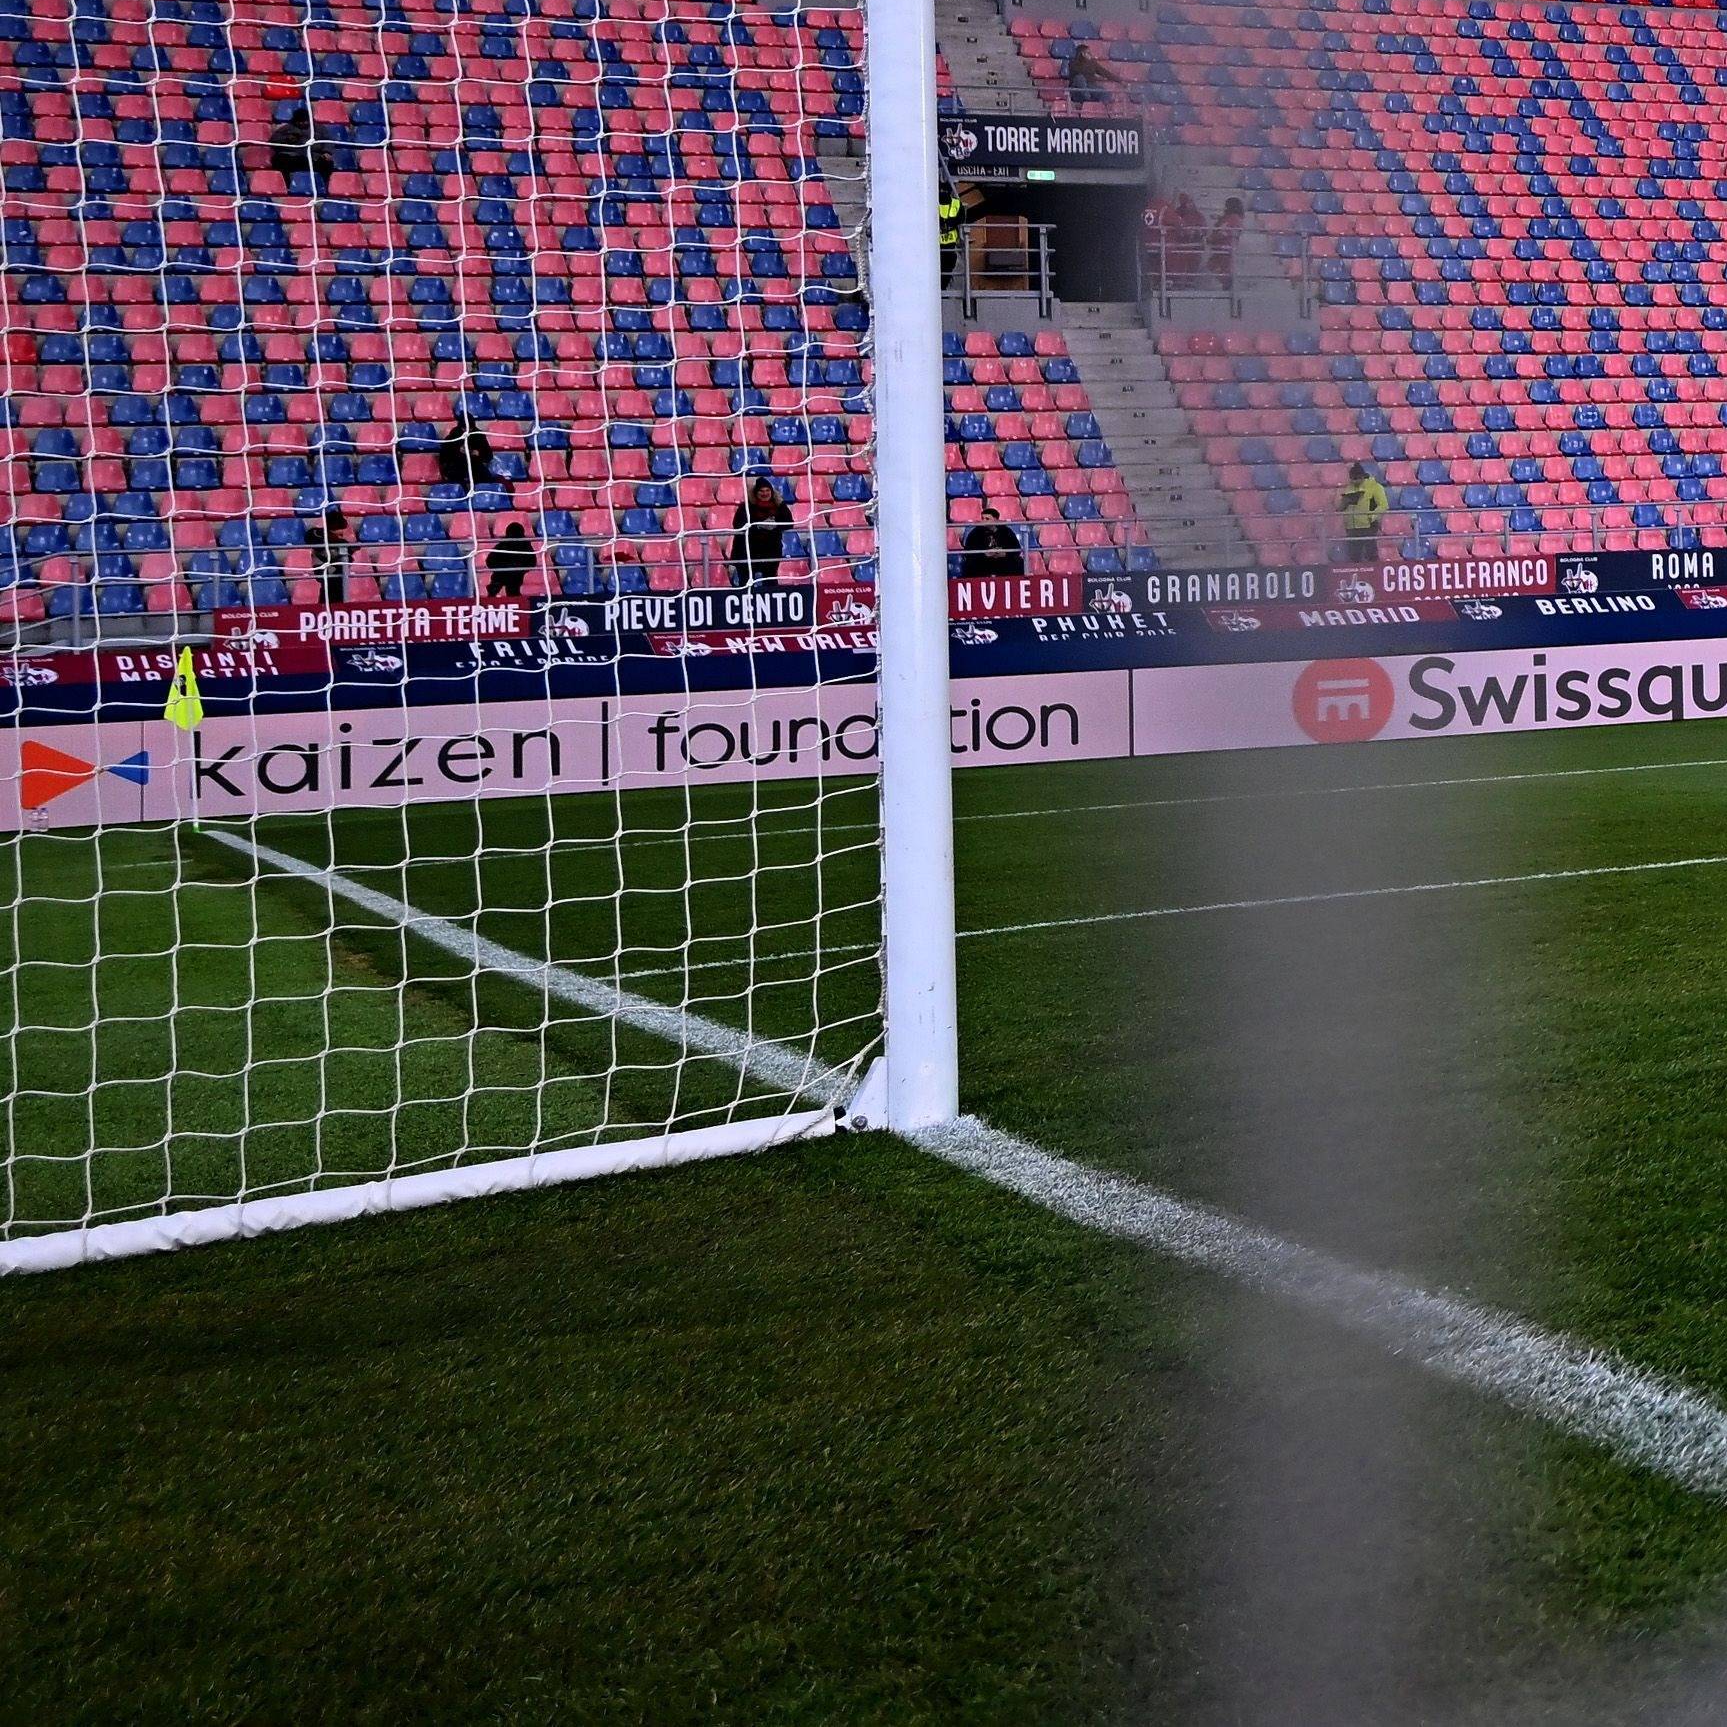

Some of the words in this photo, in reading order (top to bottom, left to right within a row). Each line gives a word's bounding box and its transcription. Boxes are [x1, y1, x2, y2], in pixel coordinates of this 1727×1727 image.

[984, 126, 1040, 152] TORRE
[1048, 127, 1139, 154] MARATONA
[1382, 559, 1548, 592] CASTELFRANCO
[1651, 552, 1714, 580] ROMA
[957, 577, 1069, 611] NVIERI
[1147, 571, 1315, 604] GRANAROLO
[604, 597, 676, 632] PIEVE
[689, 595, 713, 627] DI
[725, 591, 804, 625] CENTO
[1299, 606, 1421, 628] MADRID
[1535, 594, 1656, 616] BERLINO
[299, 607, 430, 642] PORRETTA
[441, 603, 520, 636] TERME
[1031, 611, 1168, 633] PHUKET
[468, 638, 585, 659] FRIUL
[725, 635, 784, 655] NEW
[796, 631, 879, 653] ORLEA
[115, 651, 274, 670] DISINTI
[191, 722, 561, 799] kaizen
[648, 699, 1079, 771] foundtion
